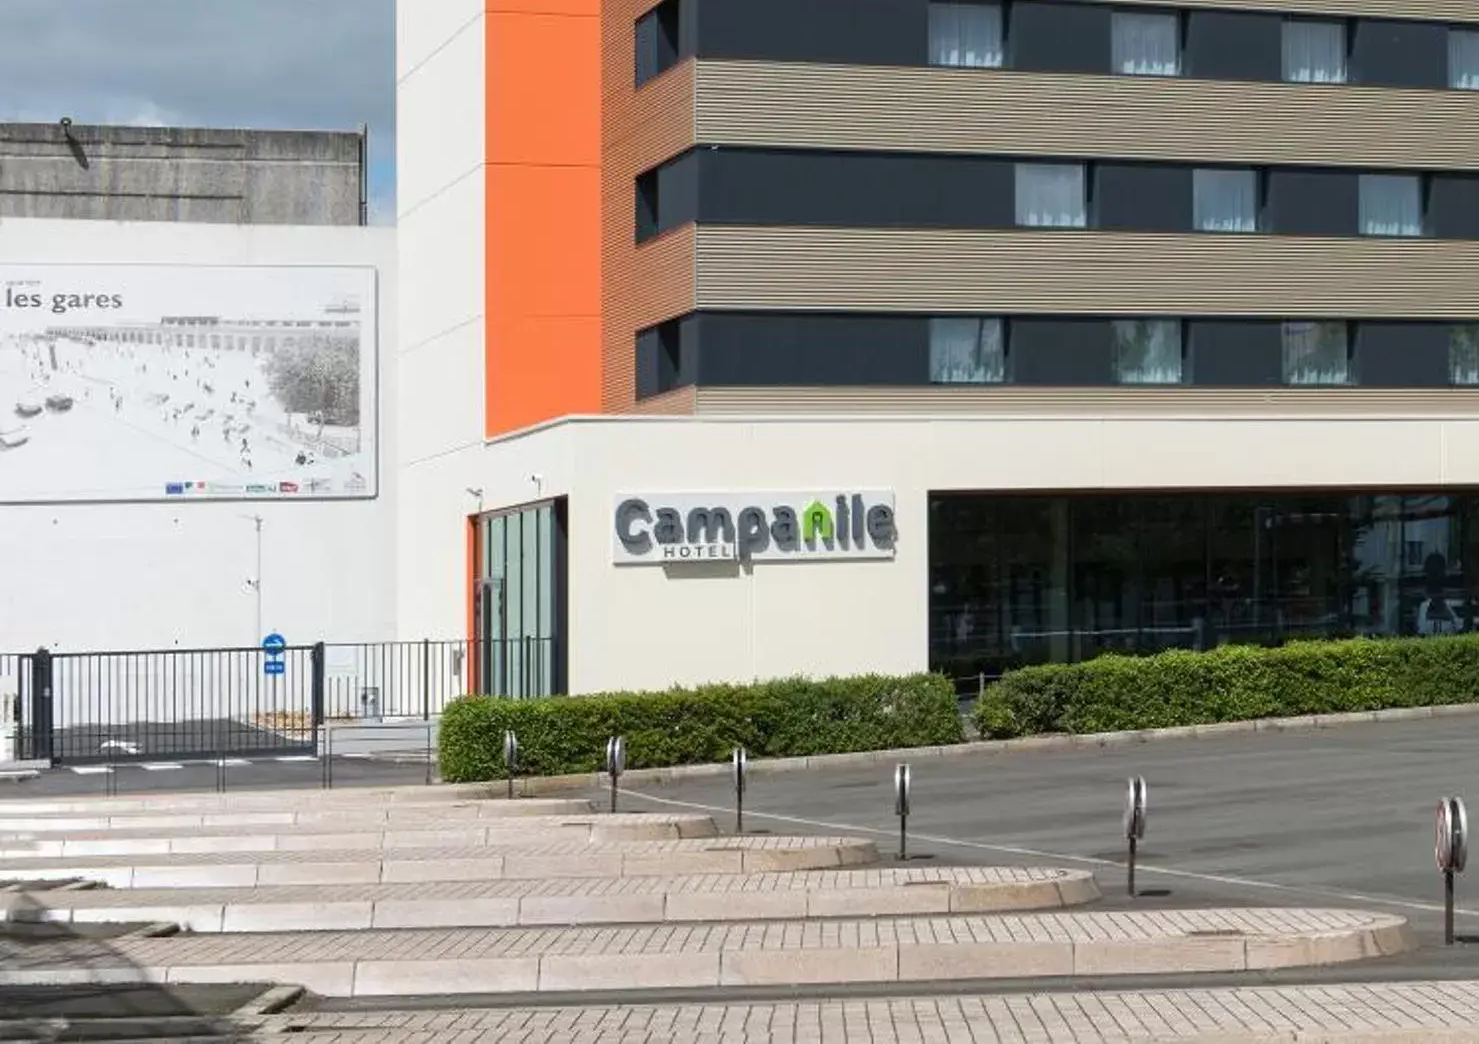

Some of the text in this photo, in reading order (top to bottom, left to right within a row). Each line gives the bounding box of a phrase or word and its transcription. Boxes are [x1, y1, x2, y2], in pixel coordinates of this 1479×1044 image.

[6, 287, 123, 314] les gares
[614, 493, 897, 573] Campanile
[663, 544, 732, 559] HOTEL
